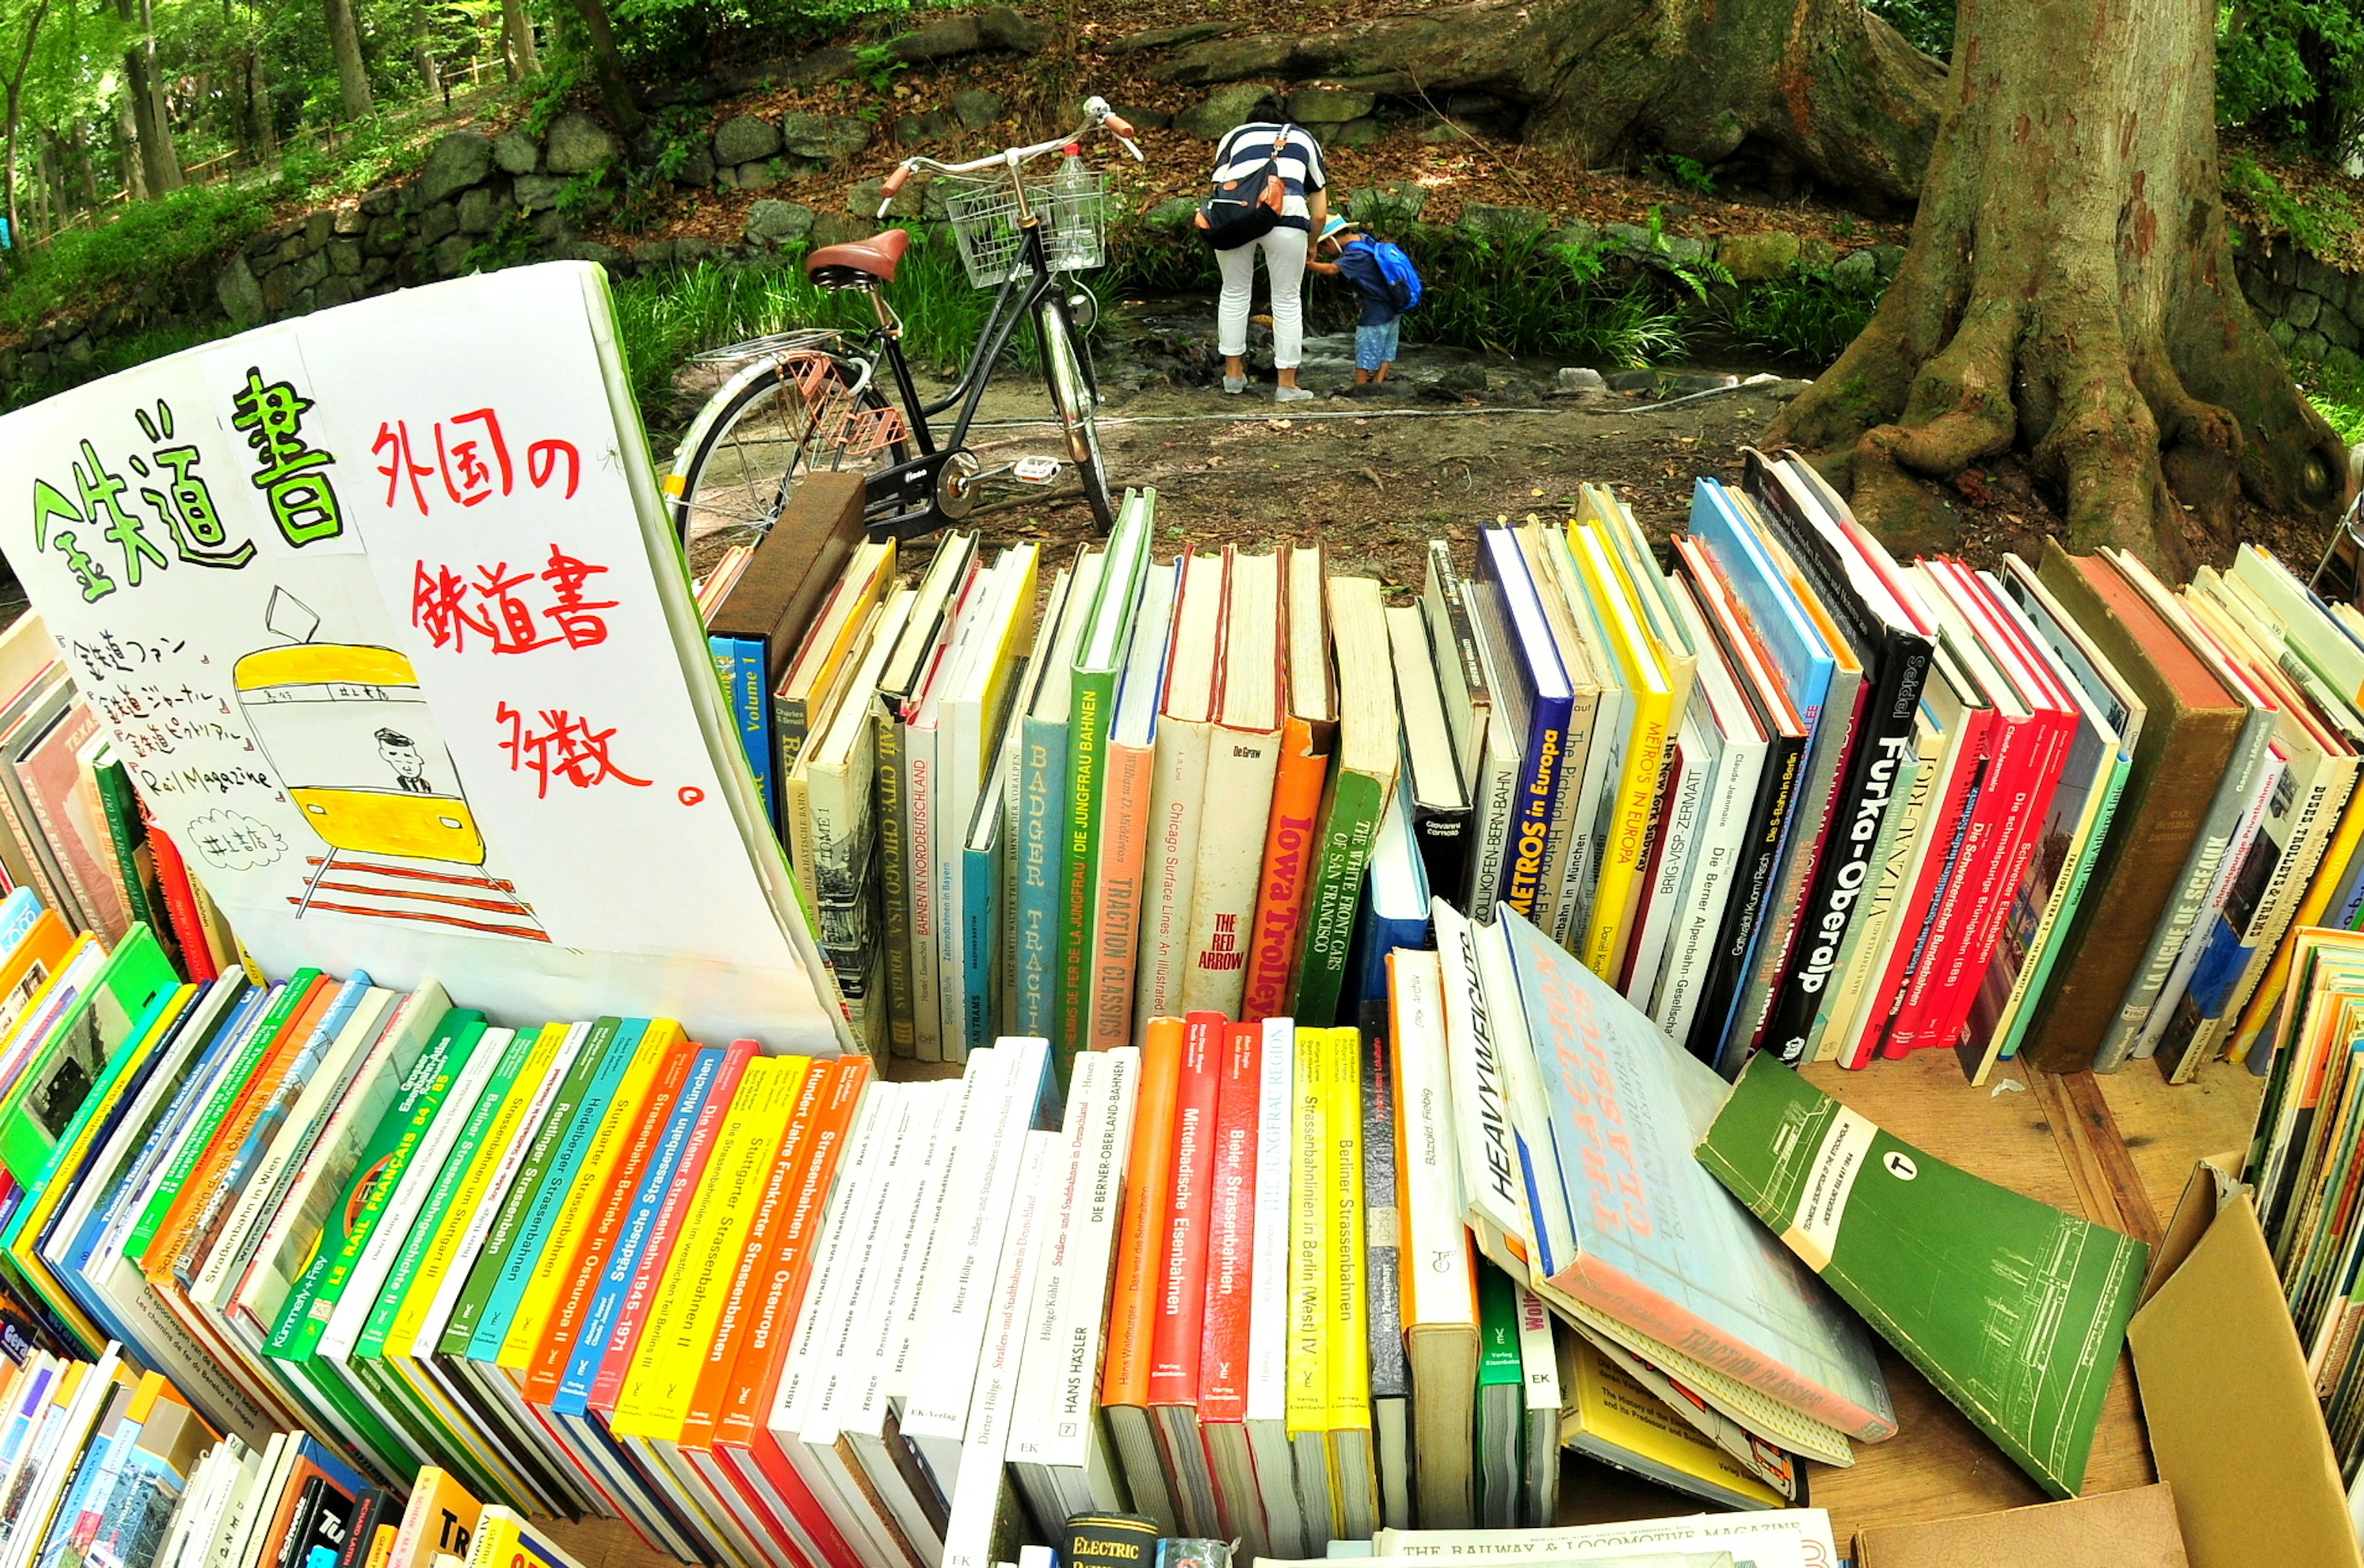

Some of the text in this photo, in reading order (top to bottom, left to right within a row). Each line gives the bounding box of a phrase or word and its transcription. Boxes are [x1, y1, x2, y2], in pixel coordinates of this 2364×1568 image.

[34, 366, 337, 603] 鉄道書
[372, 408, 579, 516] 外国の
[412, 543, 619, 655] 鉄道書
[746, 672, 762, 732] Volume
[1892, 654, 1925, 720] Seidel
[496, 701, 704, 806] 多数。
[911, 759, 928, 865] NORDDEUTSCHLAND
[1072, 690, 1096, 929] JUNGFRAU DIE JUNGFRAU BAHNEN
[1543, 730, 1584, 877] The Pictorial History
[1634, 733, 1678, 872] The New York Subway
[1729, 754, 1743, 782] Claude
[2236, 722, 2269, 792] Gaston JACOBS
[24, 776, 88, 903] TEXAS ELECTRIC
[878, 762, 902, 894] CITY: CHICAGO
[1269, 814, 1312, 901] Iowa
[1425, 821, 1461, 830] Giovanni
[1509, 728, 1559, 921] METROS Europa
[1617, 811, 1642, 864] EUROPA
[1659, 768, 1703, 895] BRIG-VISP-ZERMATT
[1867, 755, 1939, 919] VITZNAU-RIGI
[2211, 772, 2276, 909] Schmalspurige Privatbahnen
[2248, 785, 2326, 938] BUSES, TROLLEYS TRAMS
[917, 883, 929, 936] BAHNEN
[1154, 802, 1184, 1011] Chicago Surface Lines: Illustrated
[1211, 933, 1234, 952] RED
[1215, 914, 1236, 933] THE
[1314, 832, 1348, 954] OF SAN FRANCISCO
[1327, 821, 1370, 971] THE WHITE FRONT CARS
[1908, 843, 1976, 1008] Schweizerischen Bundesbahnen
[1959, 814, 2016, 956] schmalspurige Brünigbahn
[1977, 842, 2032, 964] Schweizer Eisenbahnen
[1099, 878, 1133, 1037] TRACTION CLASSICS
[1198, 951, 1244, 970] ARROW
[2153, 929, 2184, 973] LIGNE
[108, 1079, 126, 1101] Graz
[398, 1036, 452, 1113] Eisenbahn-Atlas
[400, 1053, 429, 1094] Grosser
[475, 1092, 499, 1140] Berliner
[794, 1067, 826, 1119] Hundert
[1095, 1060, 1126, 1202] BERNER-OBERLAND-BAHNEN
[102, 1063, 206, 1223] Thomas Fischer 75 Jahre Forchbahn
[238, 1076, 349, 1262] Wiener Straßenbahn-Panorama
[328, 1074, 450, 1286] LE RAIL FRANÇAIS 84 85
[435, 1097, 524, 1264] Strassenbahnen Stuttgart
[486, 1102, 571, 1256] Reutlinger Strassenbahn
[507, 1096, 603, 1282] Heidelberger Strassenbahnen
[539, 1098, 630, 1279] Stuttgarter Strassenbahnen
[609, 1056, 715, 1282] Städtische Strassenbahn München
[686, 1125, 709, 1167] Wiener
[726, 1136, 764, 1210] Stuttgarter
[779, 1118, 805, 1158] Jahre
[1303, 1095, 1318, 1218] Strassenbahnlinien
[156, 1190, 211, 1276] Schmalspurig
[206, 1156, 283, 1284] Straßenbahn Wien
[393, 1139, 473, 1292] Strassenbahngeschichte
[565, 1093, 670, 1333] Strassenbahn-Betriebe Osteuropa
[641, 1168, 689, 1271] Strassenbahn
[753, 1130, 837, 1350] Strassenbahnen Osteuropa
[754, 1158, 792, 1248] Frankfurter
[1165, 1108, 1199, 1317] Mittelbadische Eisenbahnen
[1219, 1128, 1245, 1297] Bieler Strassenbahnen
[1301, 1236, 1317, 1272] Berlin
[1337, 1139, 1356, 1321] Berliner Strassenbahnen
[685, 1215, 736, 1333] Strassenbahnen
[709, 1242, 763, 1362] Strassenbahnen
[1300, 1275, 1319, 1332] (West)
[135, 1296, 254, 1429] Les chemins Benelux images
[154, 1299, 259, 1417] spoorwegen Benelux beeld
[1063, 1325, 1090, 1417] HANS HÄSLER
[1300, 1333, 1317, 1355] IV
[1532, 1374, 1549, 1385] EK
[1601, 1387, 1645, 1412] The History
[1676, 1327, 1753, 1378] TRACTION
[1867, 1313, 1902, 1348] STOCKHOLM
[1903, 1348, 1947, 1390] UNDERGROUND
[1072, 1535, 1140, 1560] ELECTRIC
